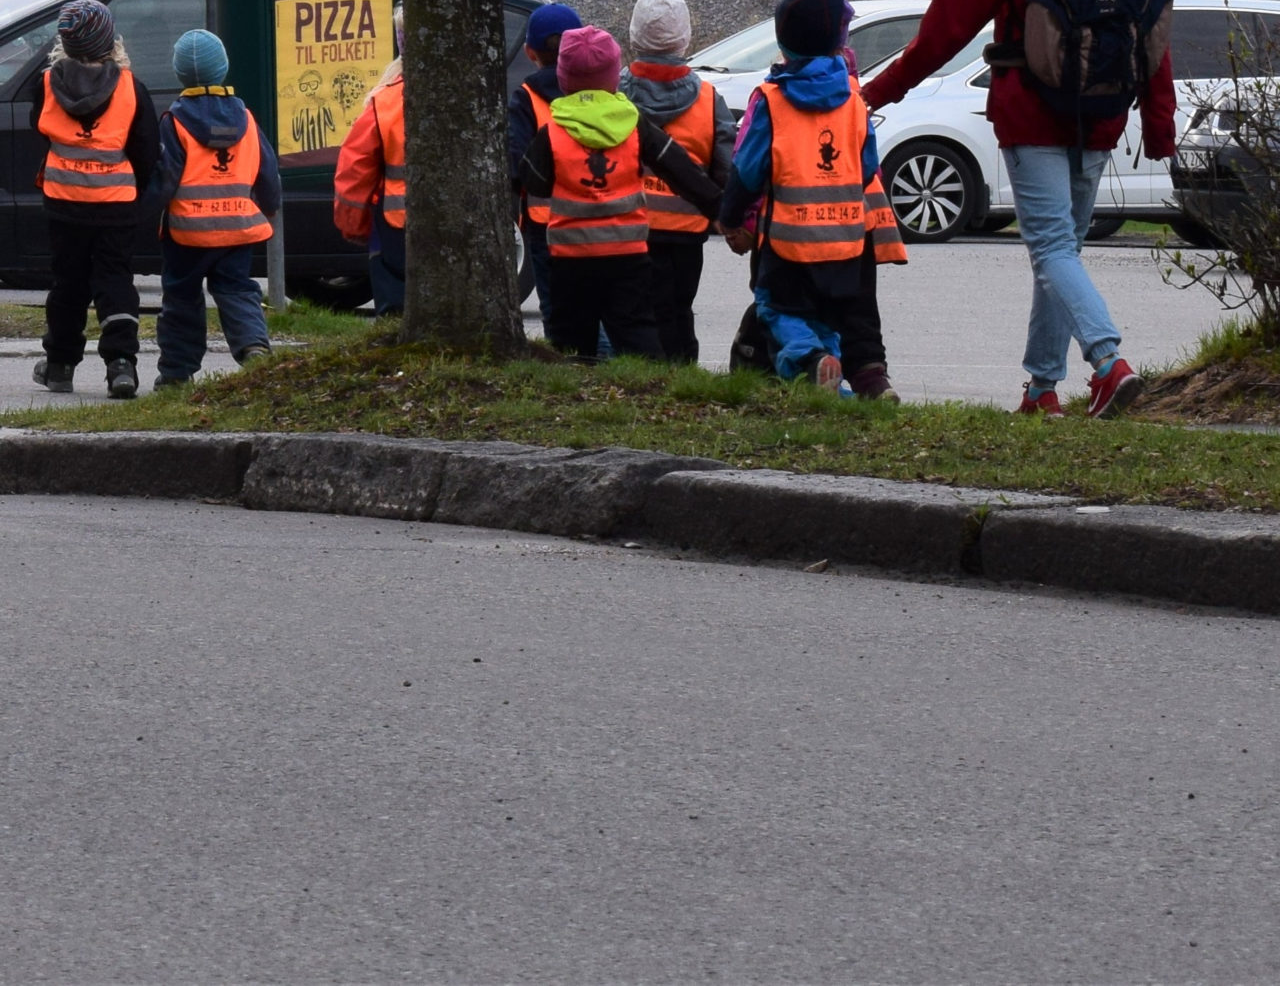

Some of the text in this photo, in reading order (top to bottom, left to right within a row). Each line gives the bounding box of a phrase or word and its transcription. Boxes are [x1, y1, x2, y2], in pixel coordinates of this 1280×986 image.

[295, 0, 376, 43] PIZZA
[295, 40, 375, 65] TIL FOLKET!
[815, 208, 825, 220] 62
[827, 207, 836, 219] 81
[839, 207, 849, 219] 14
[851, 206, 860, 219] 20
[876, 212, 887, 224] 14
